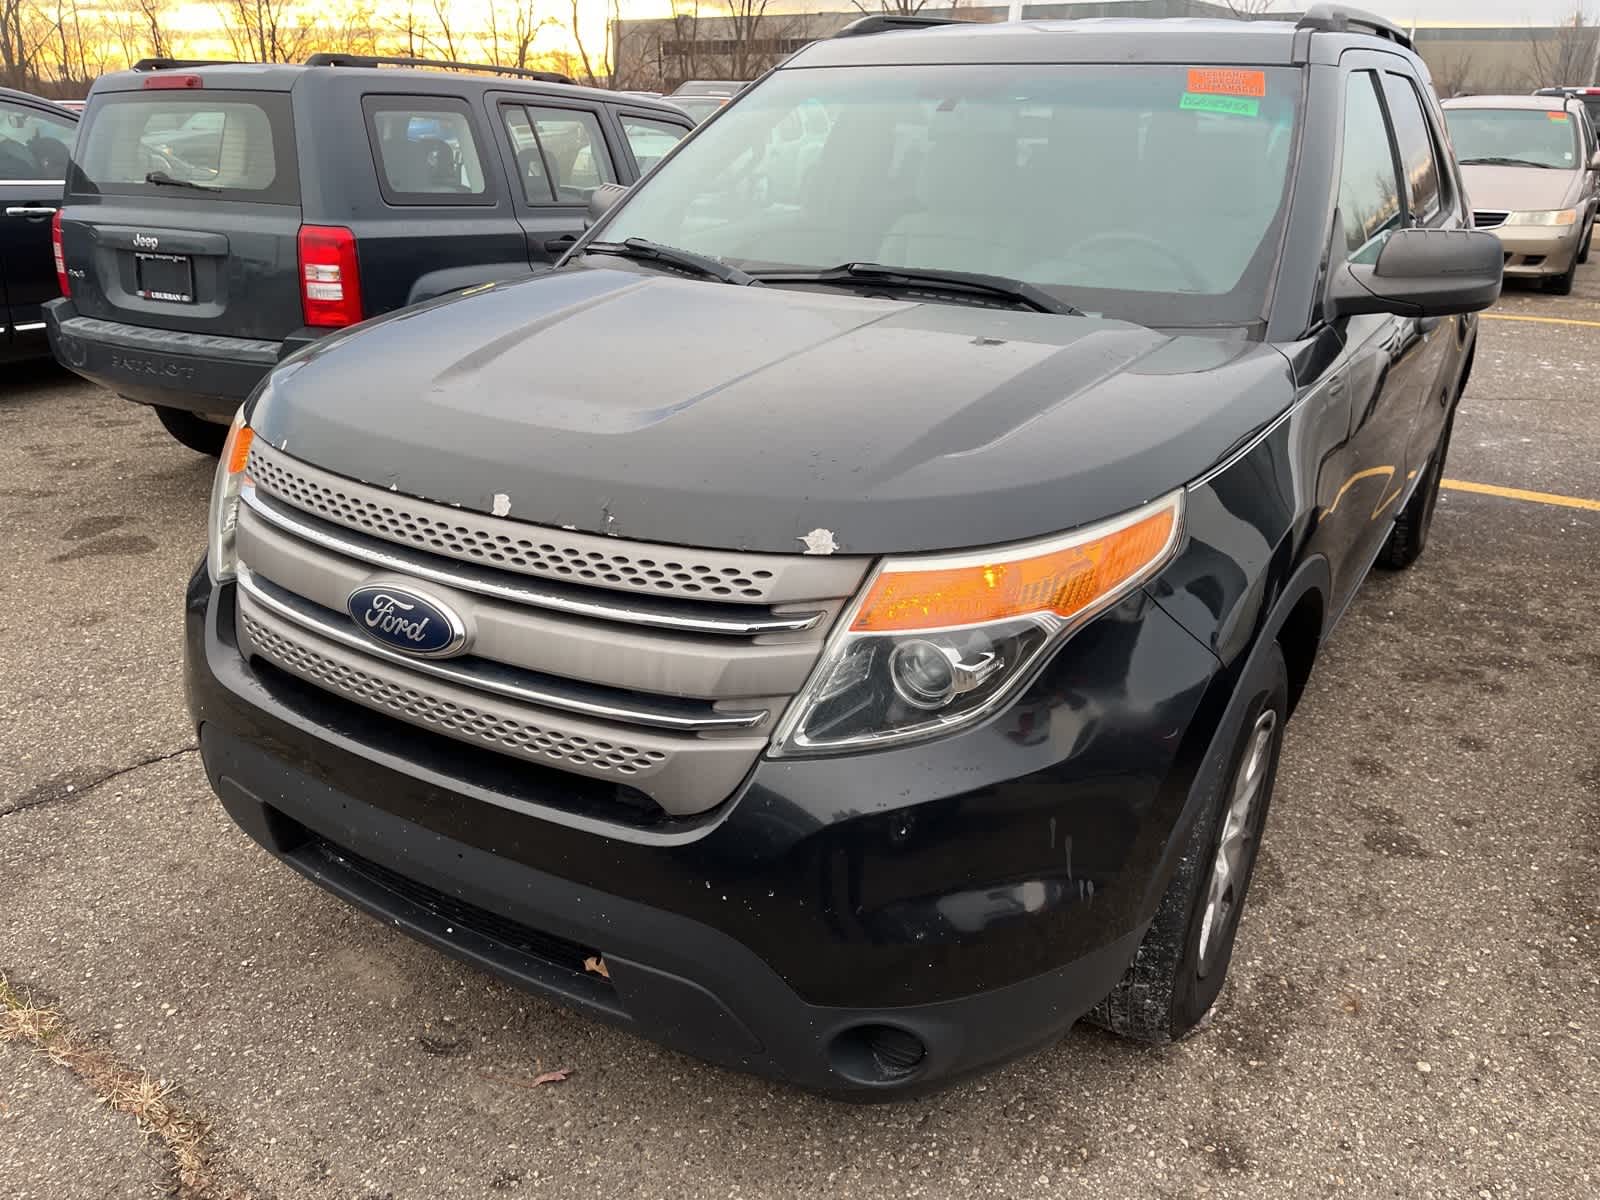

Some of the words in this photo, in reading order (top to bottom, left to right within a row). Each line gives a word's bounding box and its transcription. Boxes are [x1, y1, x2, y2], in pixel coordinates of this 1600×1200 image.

[133, 233, 158, 250] Jeep
[112, 354, 193, 379] PATRIOT
[365, 594, 430, 642] Ford
